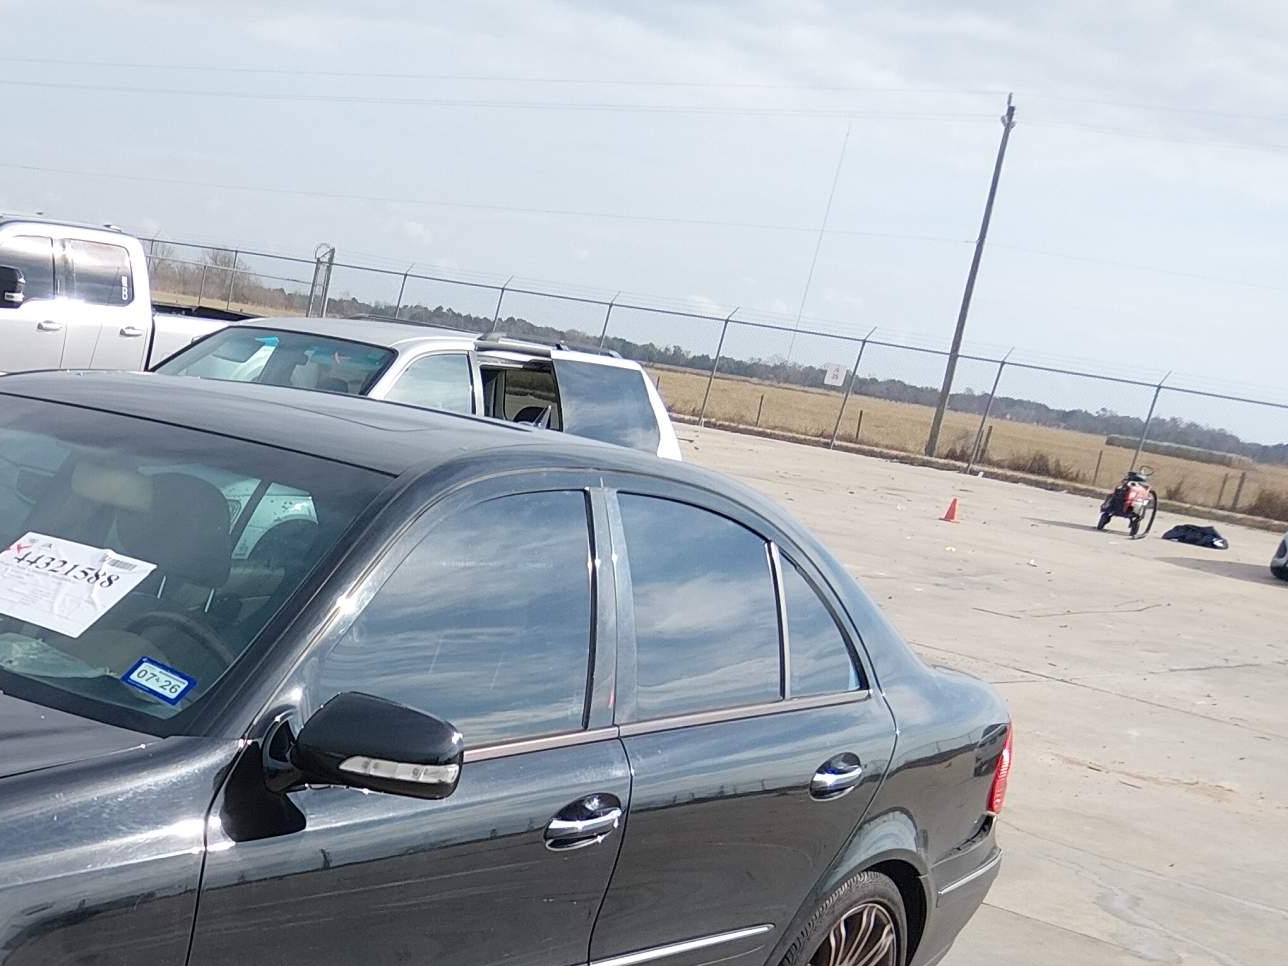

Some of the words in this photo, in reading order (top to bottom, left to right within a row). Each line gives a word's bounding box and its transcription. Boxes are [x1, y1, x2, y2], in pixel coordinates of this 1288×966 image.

[14, 551, 120, 589] 44321588
[136, 669, 157, 682] 07
[159, 680, 181, 694] 26
